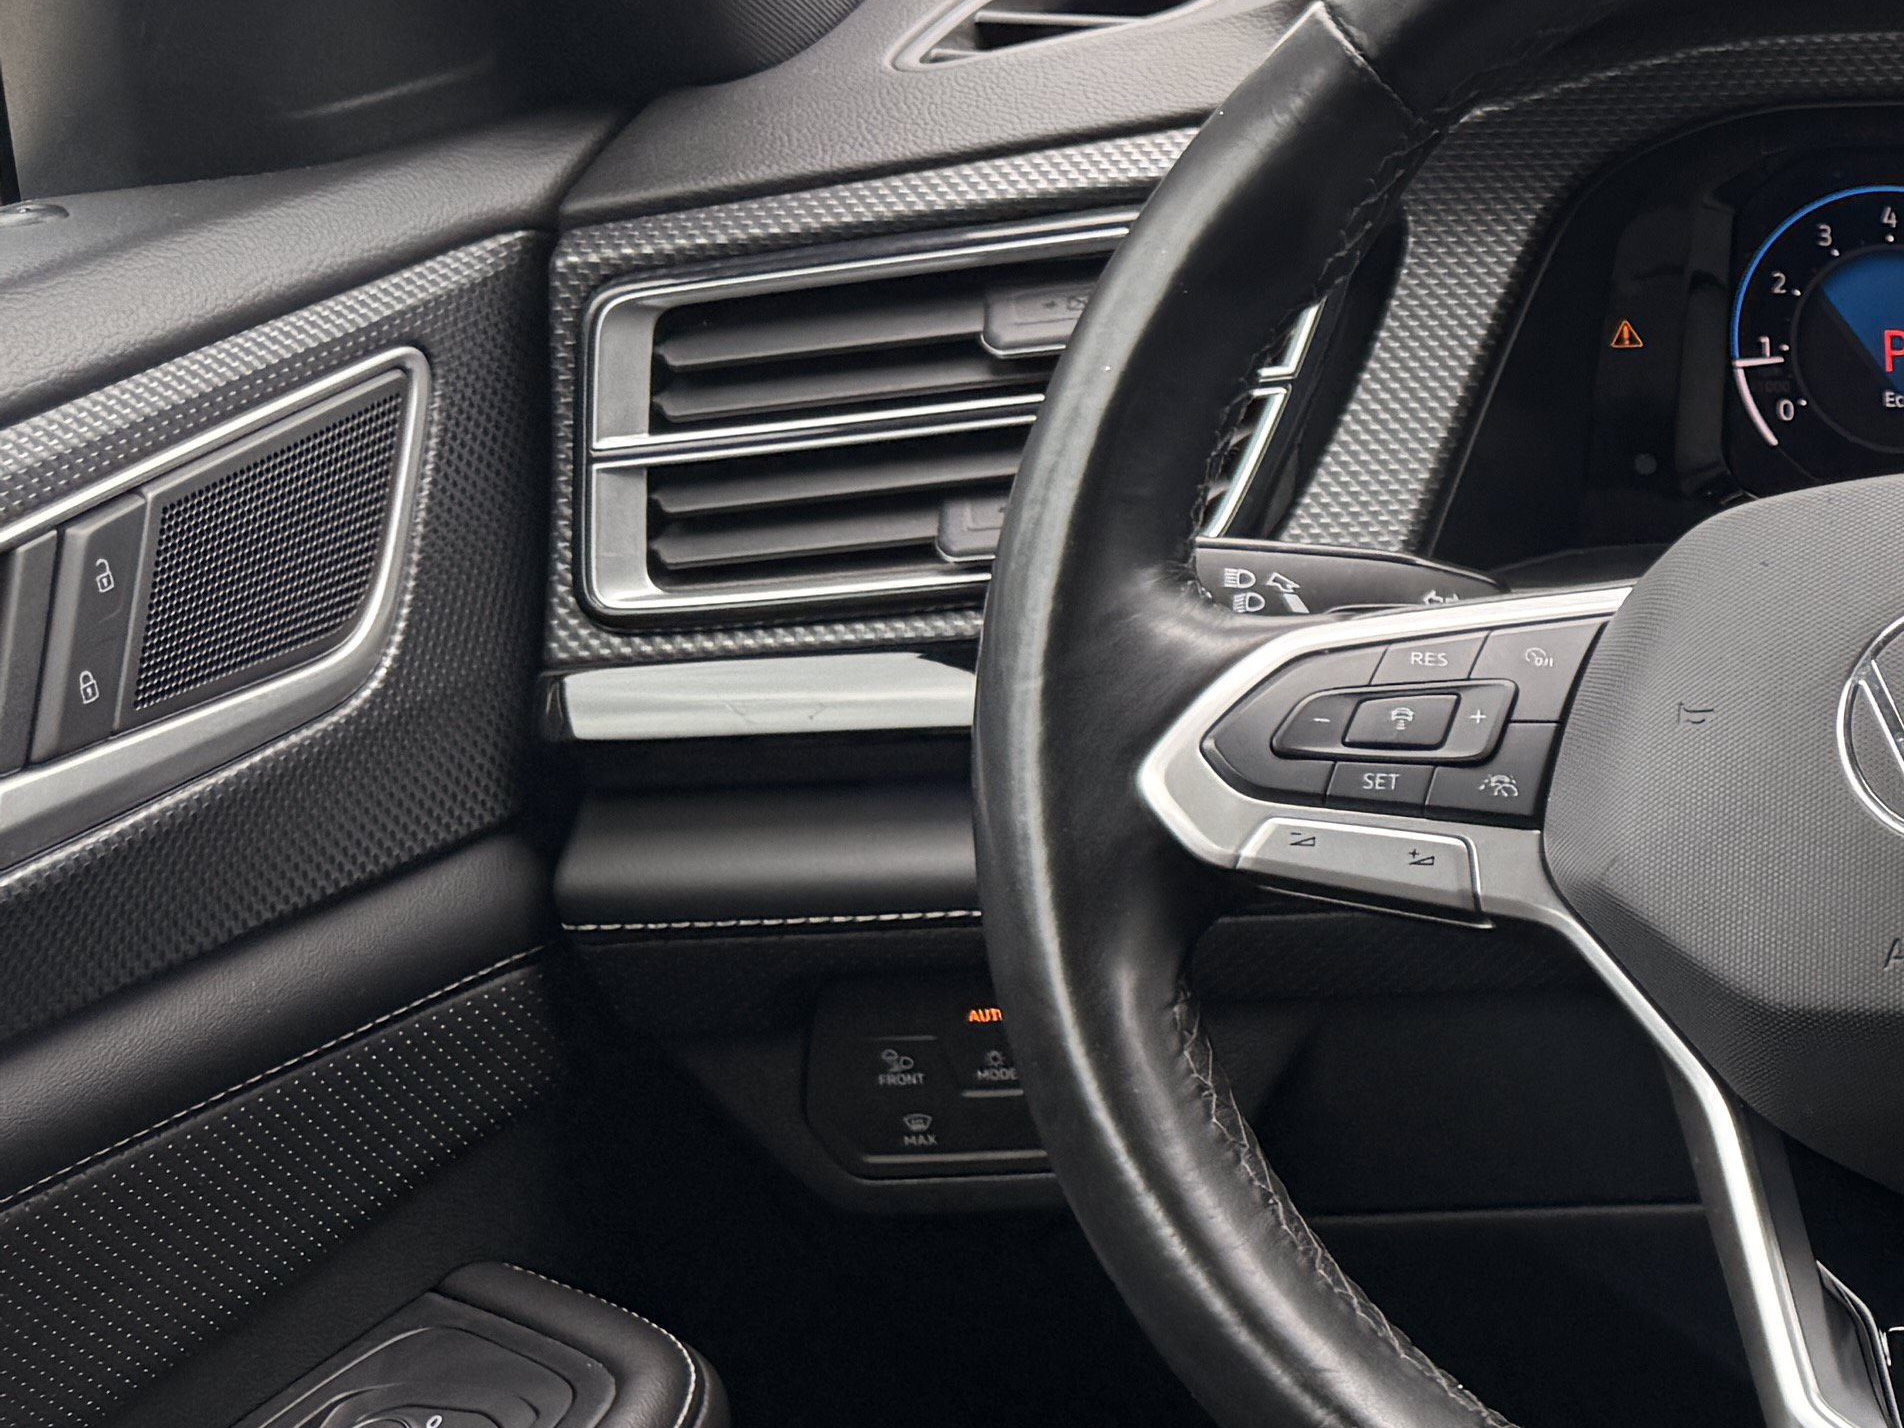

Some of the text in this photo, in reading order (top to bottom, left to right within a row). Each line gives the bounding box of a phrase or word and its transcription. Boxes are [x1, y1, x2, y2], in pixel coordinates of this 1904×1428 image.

[1883, 207, 1896, 227] 4
[1819, 225, 1832, 246] 3
[1773, 272, 1786, 293] 2
[1760, 337, 1770, 357] 1
[1779, 400, 1794, 420] 0
[1411, 652, 1448, 666] RES
[1363, 773, 1399, 789] SET
[969, 1008, 1002, 1022] AUT
[879, 1073, 923, 1085] FRONT
[904, 1135, 937, 1145] MAX
